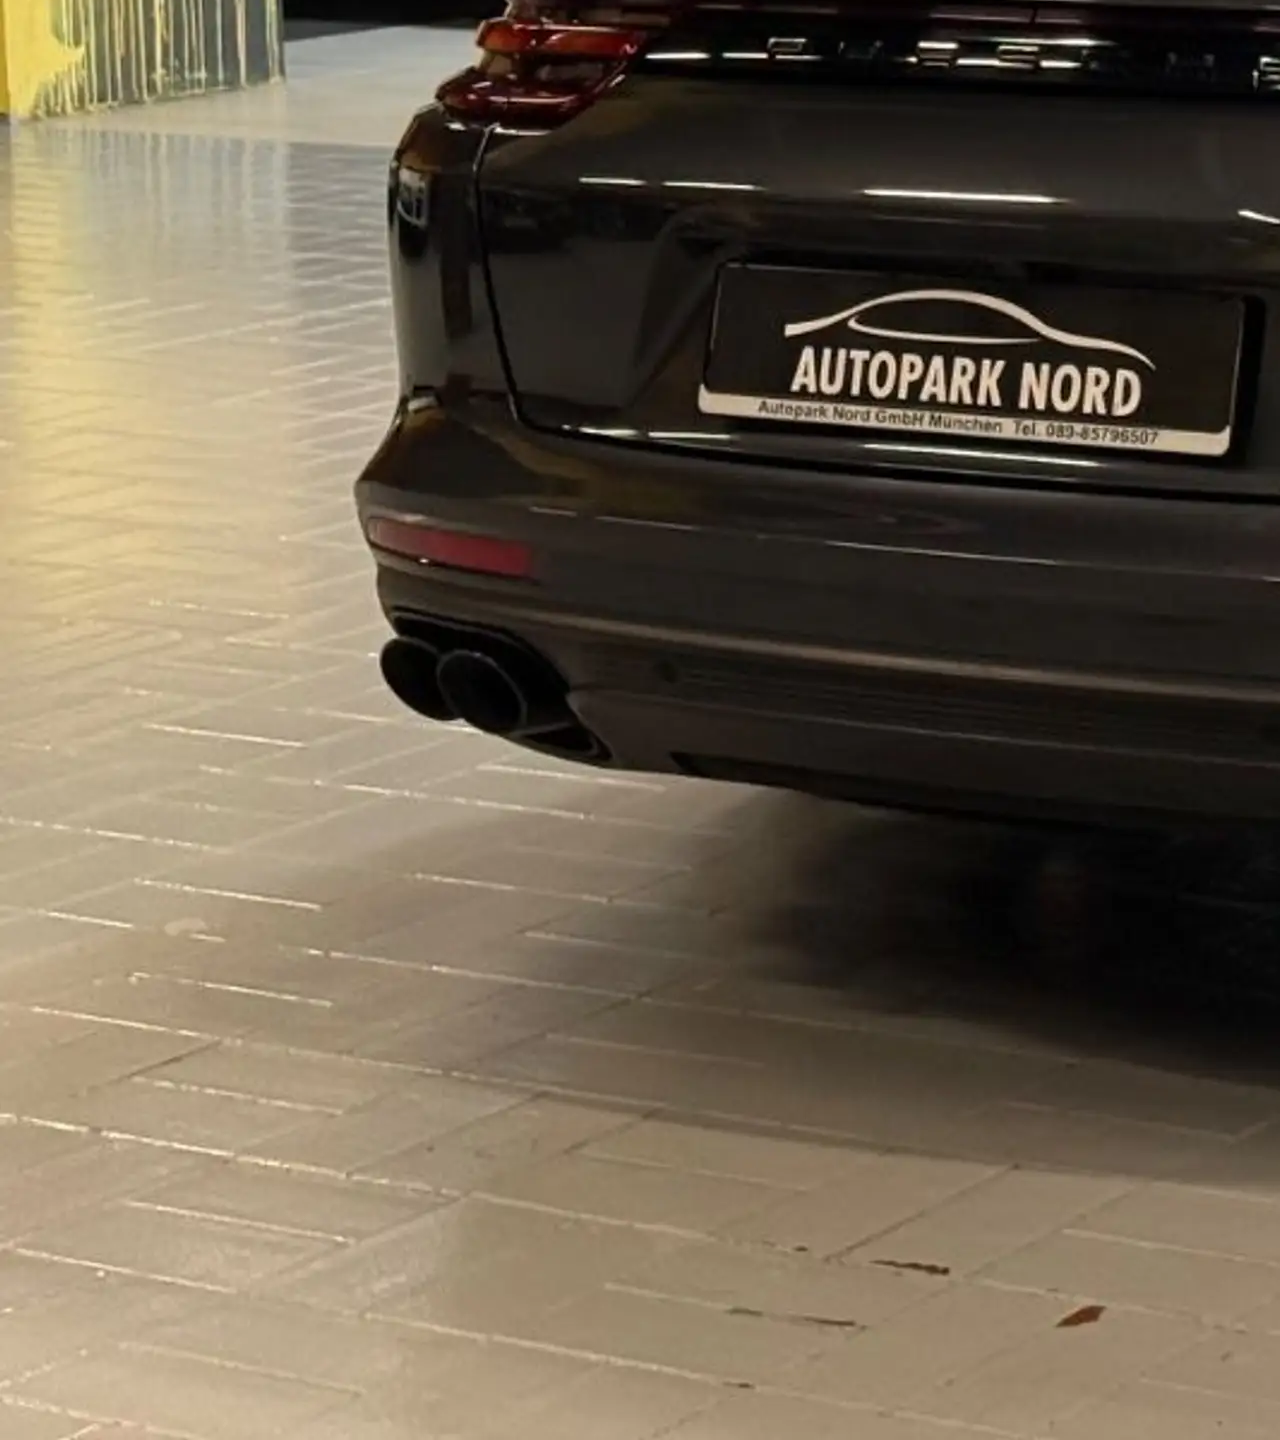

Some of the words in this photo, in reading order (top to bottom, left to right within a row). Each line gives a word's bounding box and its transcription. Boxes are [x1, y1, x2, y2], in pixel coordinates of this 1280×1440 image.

[789, 344, 1006, 408] AUTOPARK
[1016, 360, 1144, 417] NORD
[758, 400, 828, 419] Autopark
[831, 404, 872, 423] Nord
[874, 408, 925, 427] GmbH
[1011, 420, 1042, 438] Tel.
